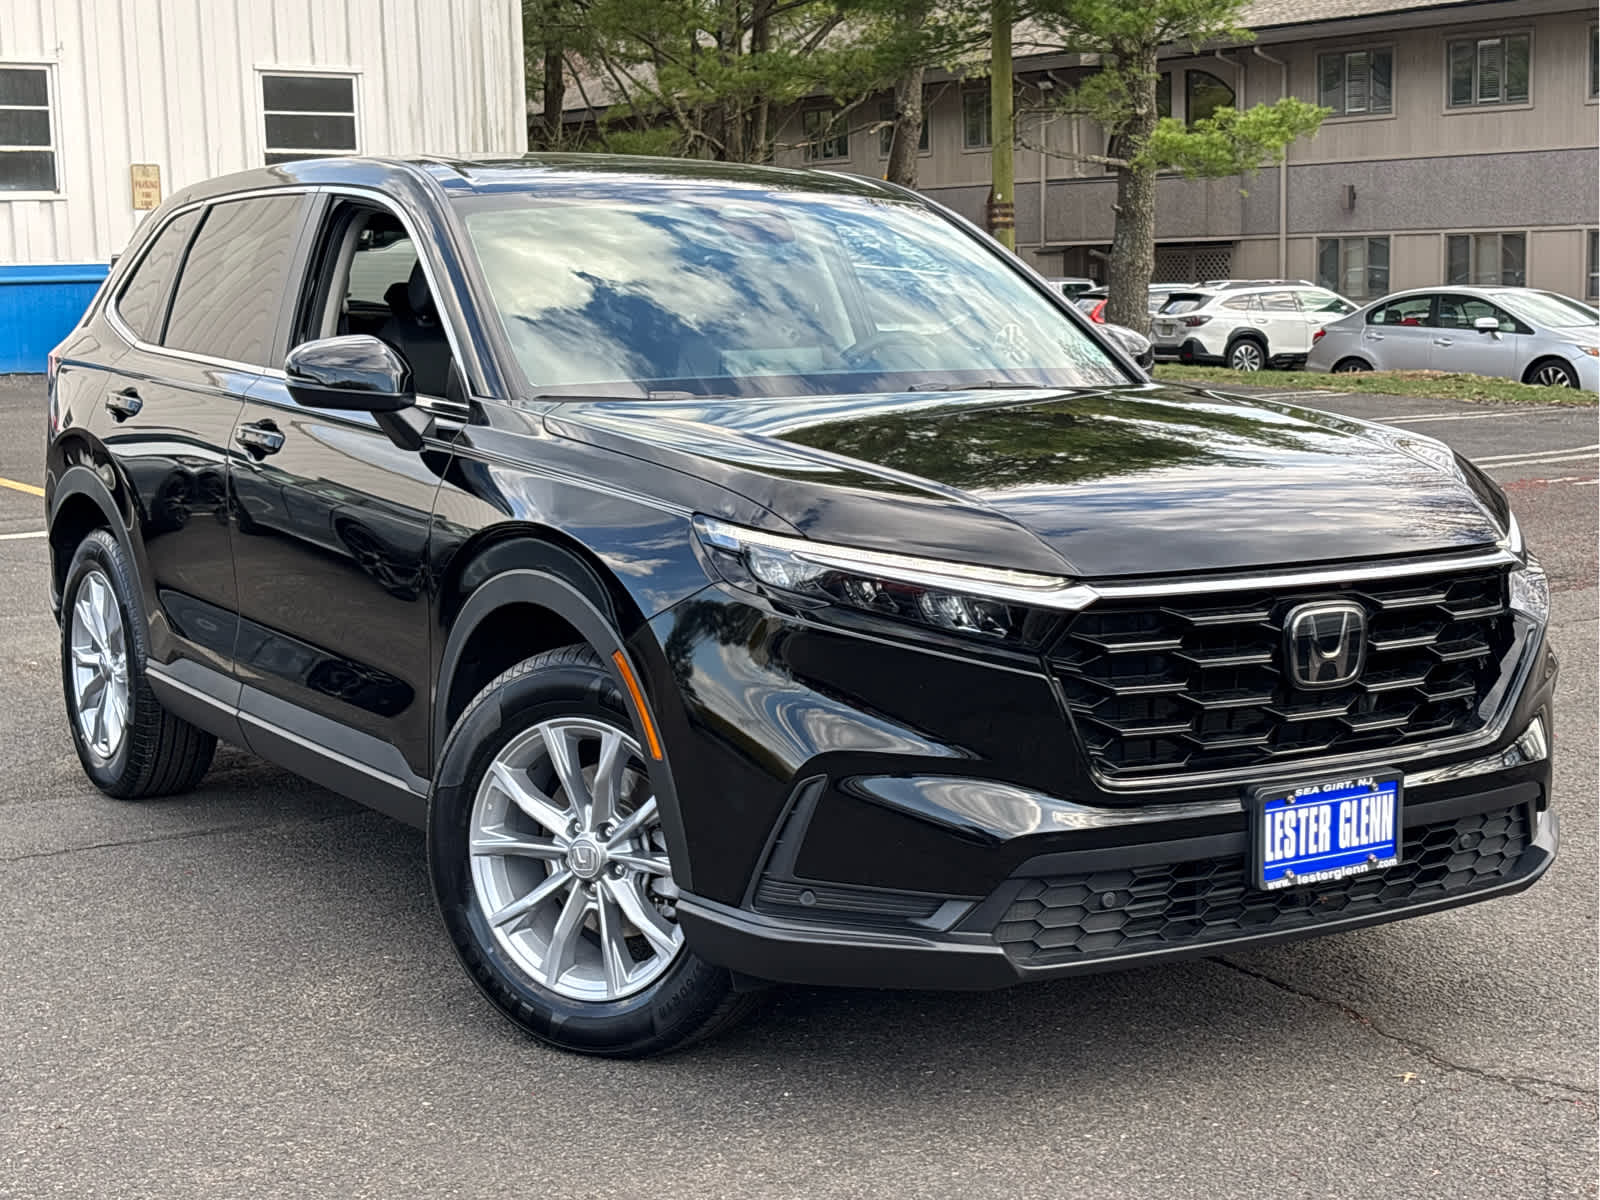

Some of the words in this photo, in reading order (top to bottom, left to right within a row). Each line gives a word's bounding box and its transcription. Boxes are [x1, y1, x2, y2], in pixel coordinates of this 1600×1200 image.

[1294, 785, 1320, 797] SEA
[1357, 777, 1374, 787] NJ
[1264, 804, 1332, 862] LESTER
[1338, 793, 1395, 849] GLENN
[1267, 879, 1291, 890] www.
[1296, 864, 1369, 885] lesterglenn
[1376, 858, 1398, 869] .com
